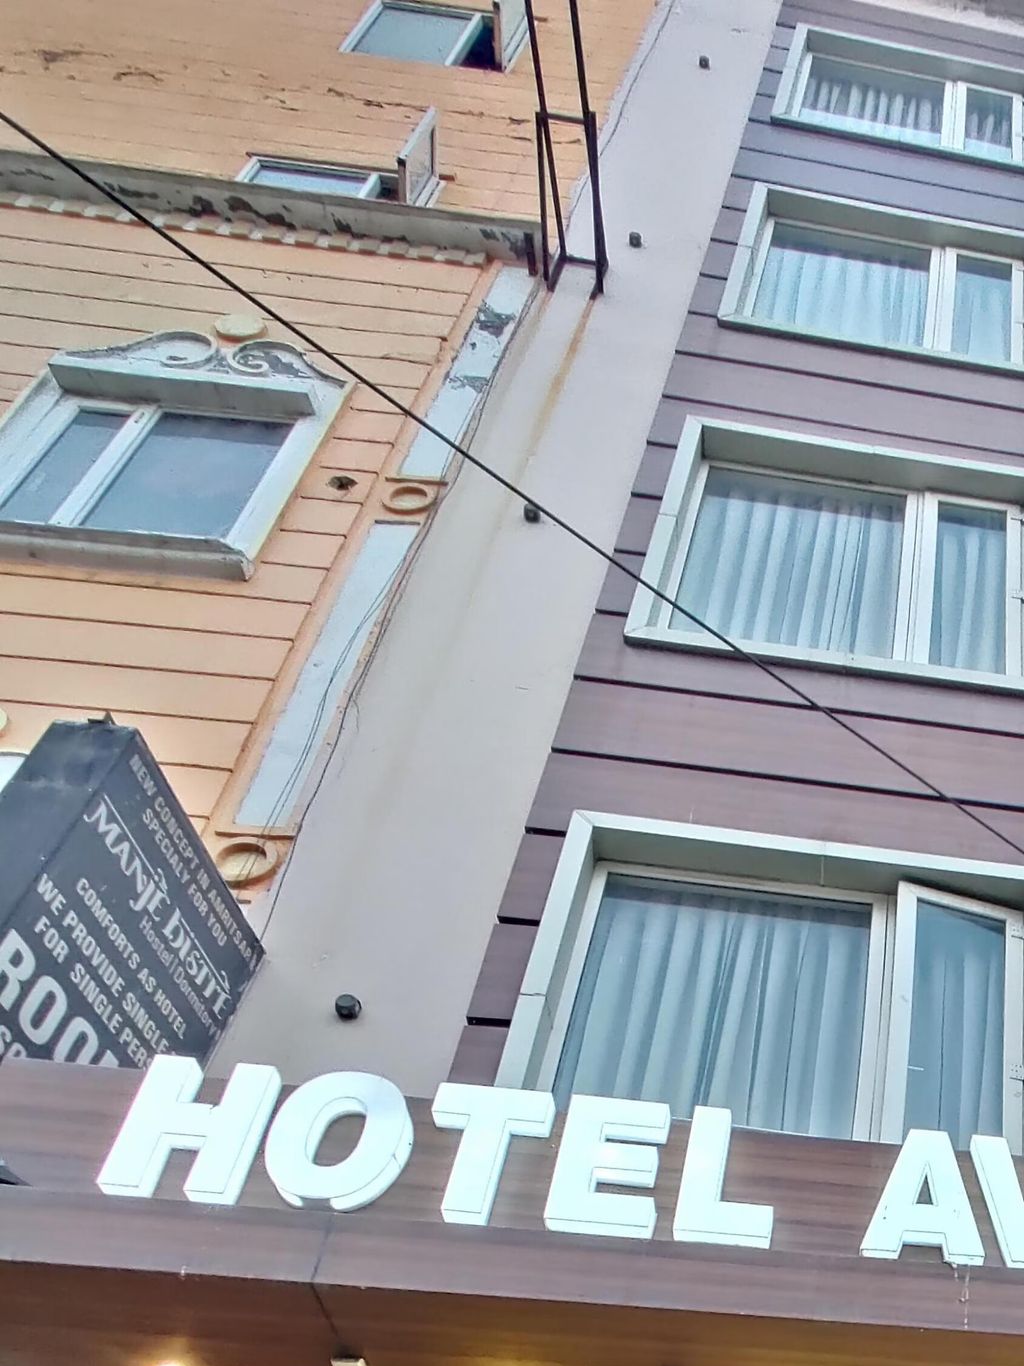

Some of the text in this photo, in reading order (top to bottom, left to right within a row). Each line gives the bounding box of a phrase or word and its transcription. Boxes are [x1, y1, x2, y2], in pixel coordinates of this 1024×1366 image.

[129, 754, 158, 798] NEW
[154, 797, 200, 870] CONCEPT
[197, 867, 211, 889] IN
[142, 808, 228, 947] SPECIALY FOR YOU
[0, 928, 119, 1067] ROO
[34, 916, 70, 964] FOR
[69, 963, 123, 1034] SINGLE
[36, 872, 169, 1054] WE PROVIDE SINGLE
[76, 878, 187, 1040] COMFORTS AS HOTEL
[97, 1055, 775, 1249] HOTEL
